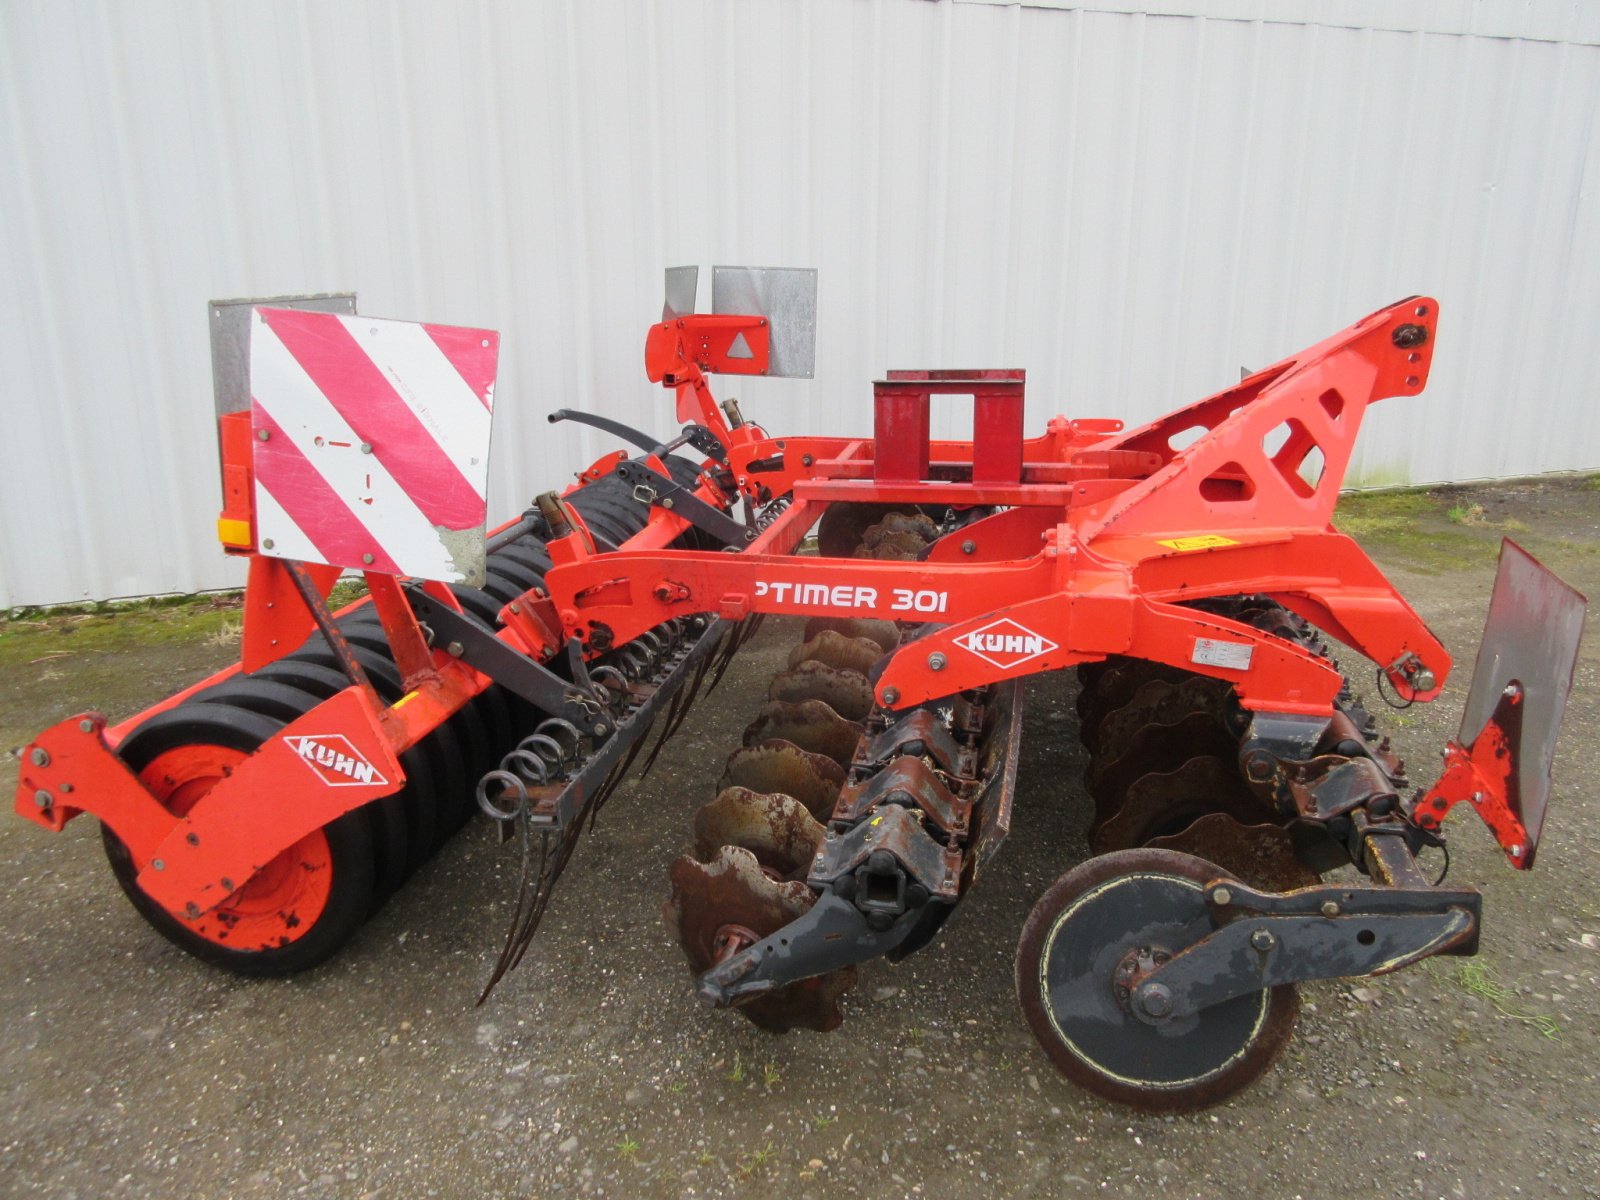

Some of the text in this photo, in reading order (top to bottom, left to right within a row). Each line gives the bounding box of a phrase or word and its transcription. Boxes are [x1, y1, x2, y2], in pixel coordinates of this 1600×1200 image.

[891, 588, 948, 613] 301
[968, 633, 1043, 655] KUHN
[298, 737, 374, 784] KUHN
